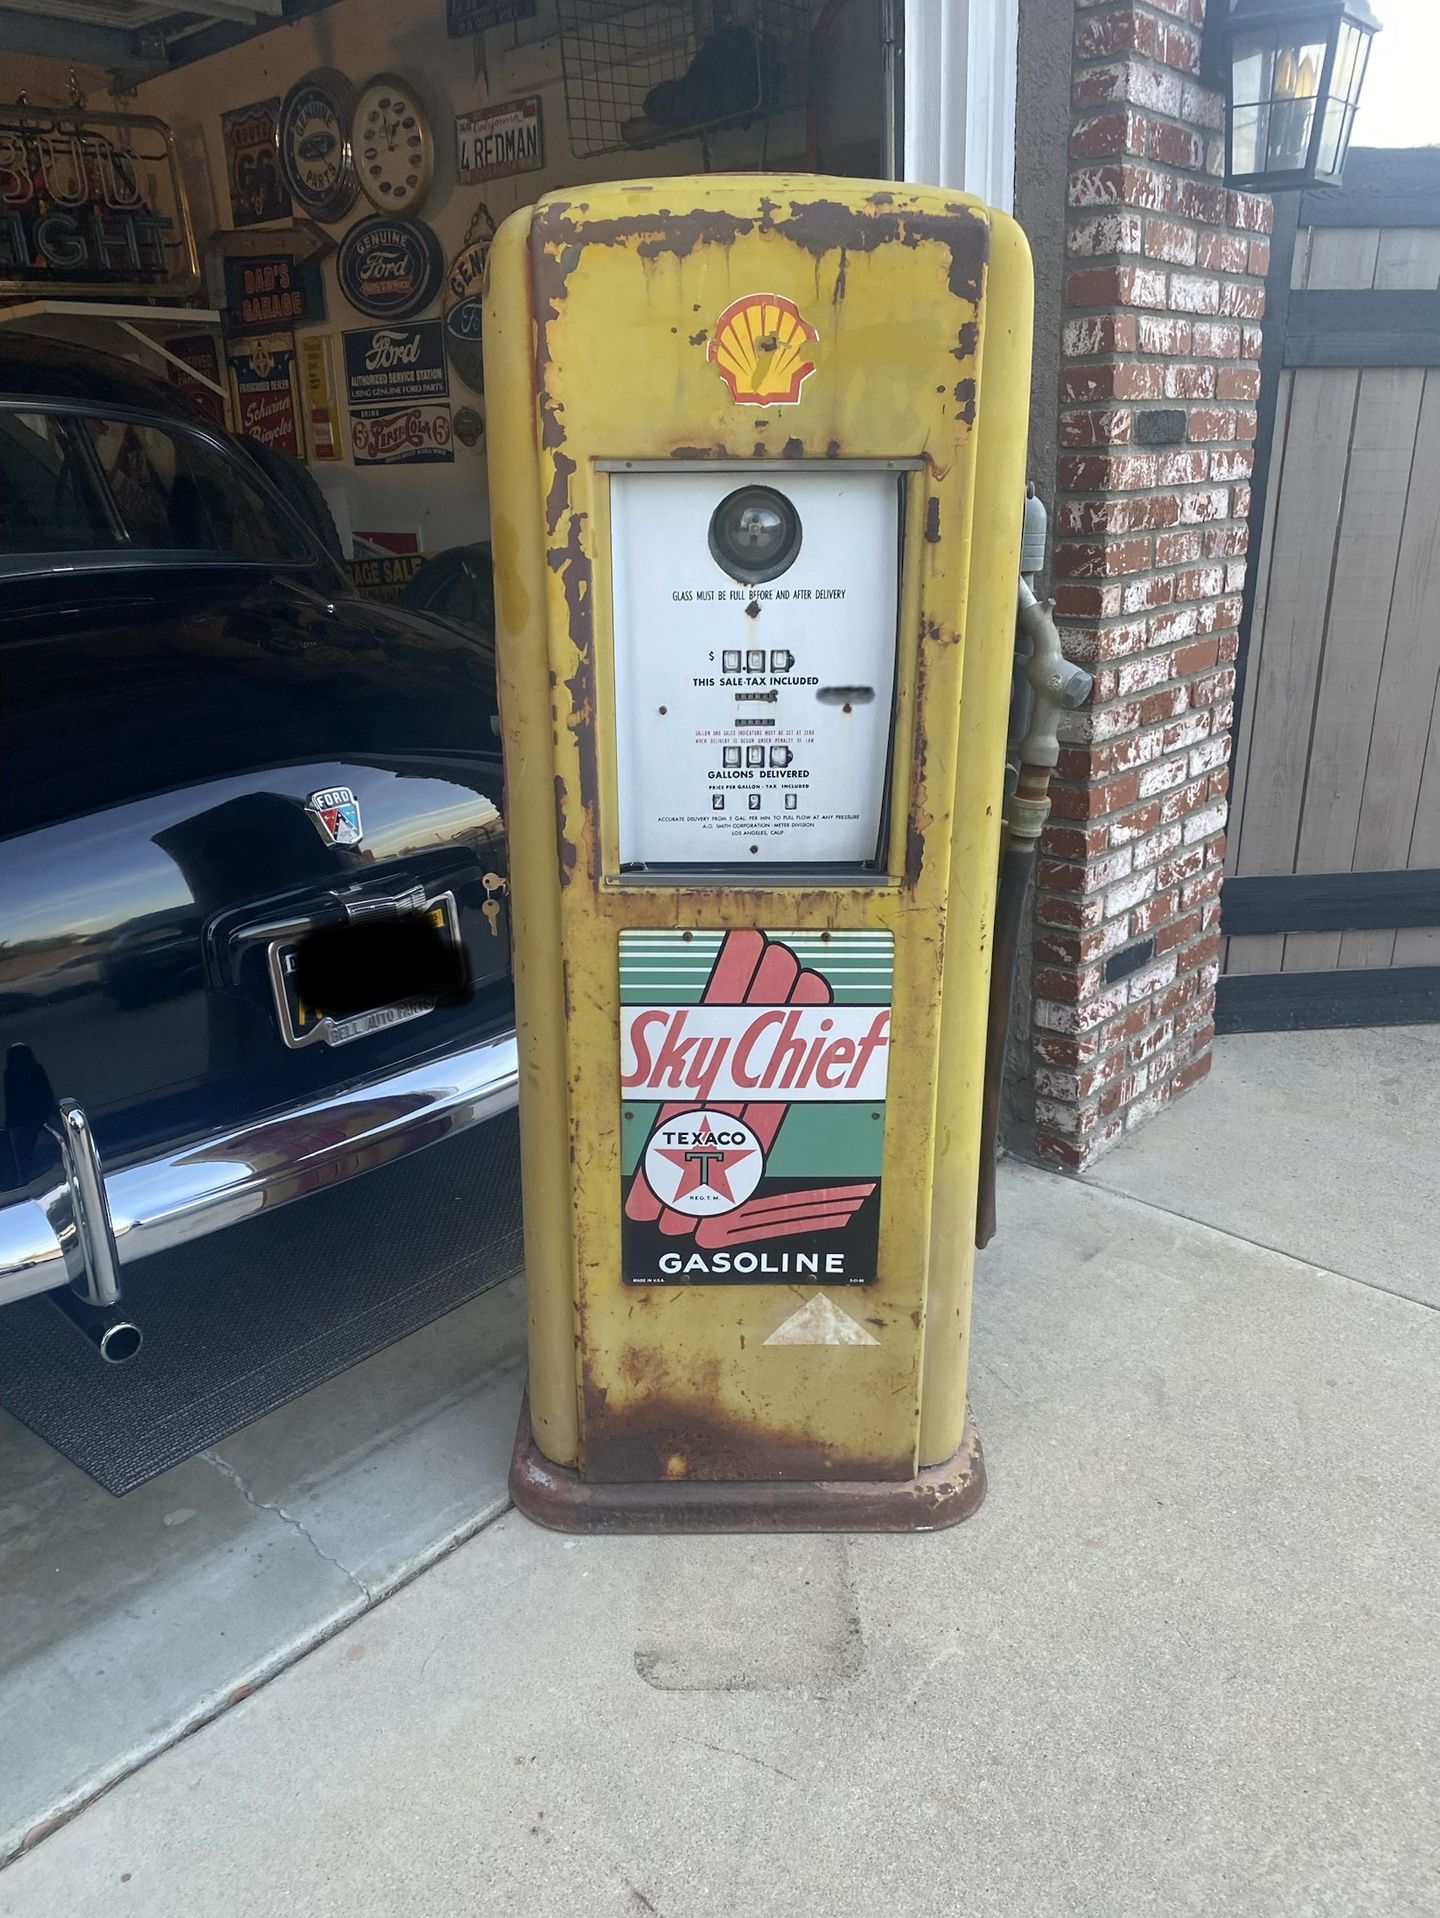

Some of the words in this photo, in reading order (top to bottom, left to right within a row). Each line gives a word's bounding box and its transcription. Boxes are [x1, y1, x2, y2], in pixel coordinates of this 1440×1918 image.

[460, 140, 470, 171] 4
[474, 125, 538, 169] REDMAN
[2, 211, 173, 271] IGHT
[356, 231, 410, 253] GENUINE
[360, 252, 410, 279] Ford
[244, 263, 290, 295] DAD'S
[242, 291, 303, 322] GARAGE
[365, 330, 422, 370] Ford
[416, 367, 443, 381] STATION
[244, 395, 291, 427] Schwinn
[672, 590, 693, 601] GLASS
[697, 590, 714, 600] MUST
[718, 590, 726, 600] BE
[730, 590, 745, 600] FULL
[749, 589, 773, 600] BEFORE
[776, 589, 790, 600] AND
[793, 589, 812, 600] AFTER
[815, 589, 846, 600] DELIVERY
[709, 651, 715, 661] $
[693, 678, 715, 686] THIS
[770, 677, 819, 685] INCLUDED
[708, 771, 754, 779] GALLONS
[760, 770, 810, 778] DELIVERED
[316, 790, 350, 807] FORD
[367, 1011, 396, 1031] AUTO
[621, 1009, 732, 1100] Sky
[731, 1009, 891, 1089] Chief
[662, 1131, 746, 1145] TEXACO
[684, 1151, 724, 1186] T
[658, 1252, 845, 1275] GASOLINE
